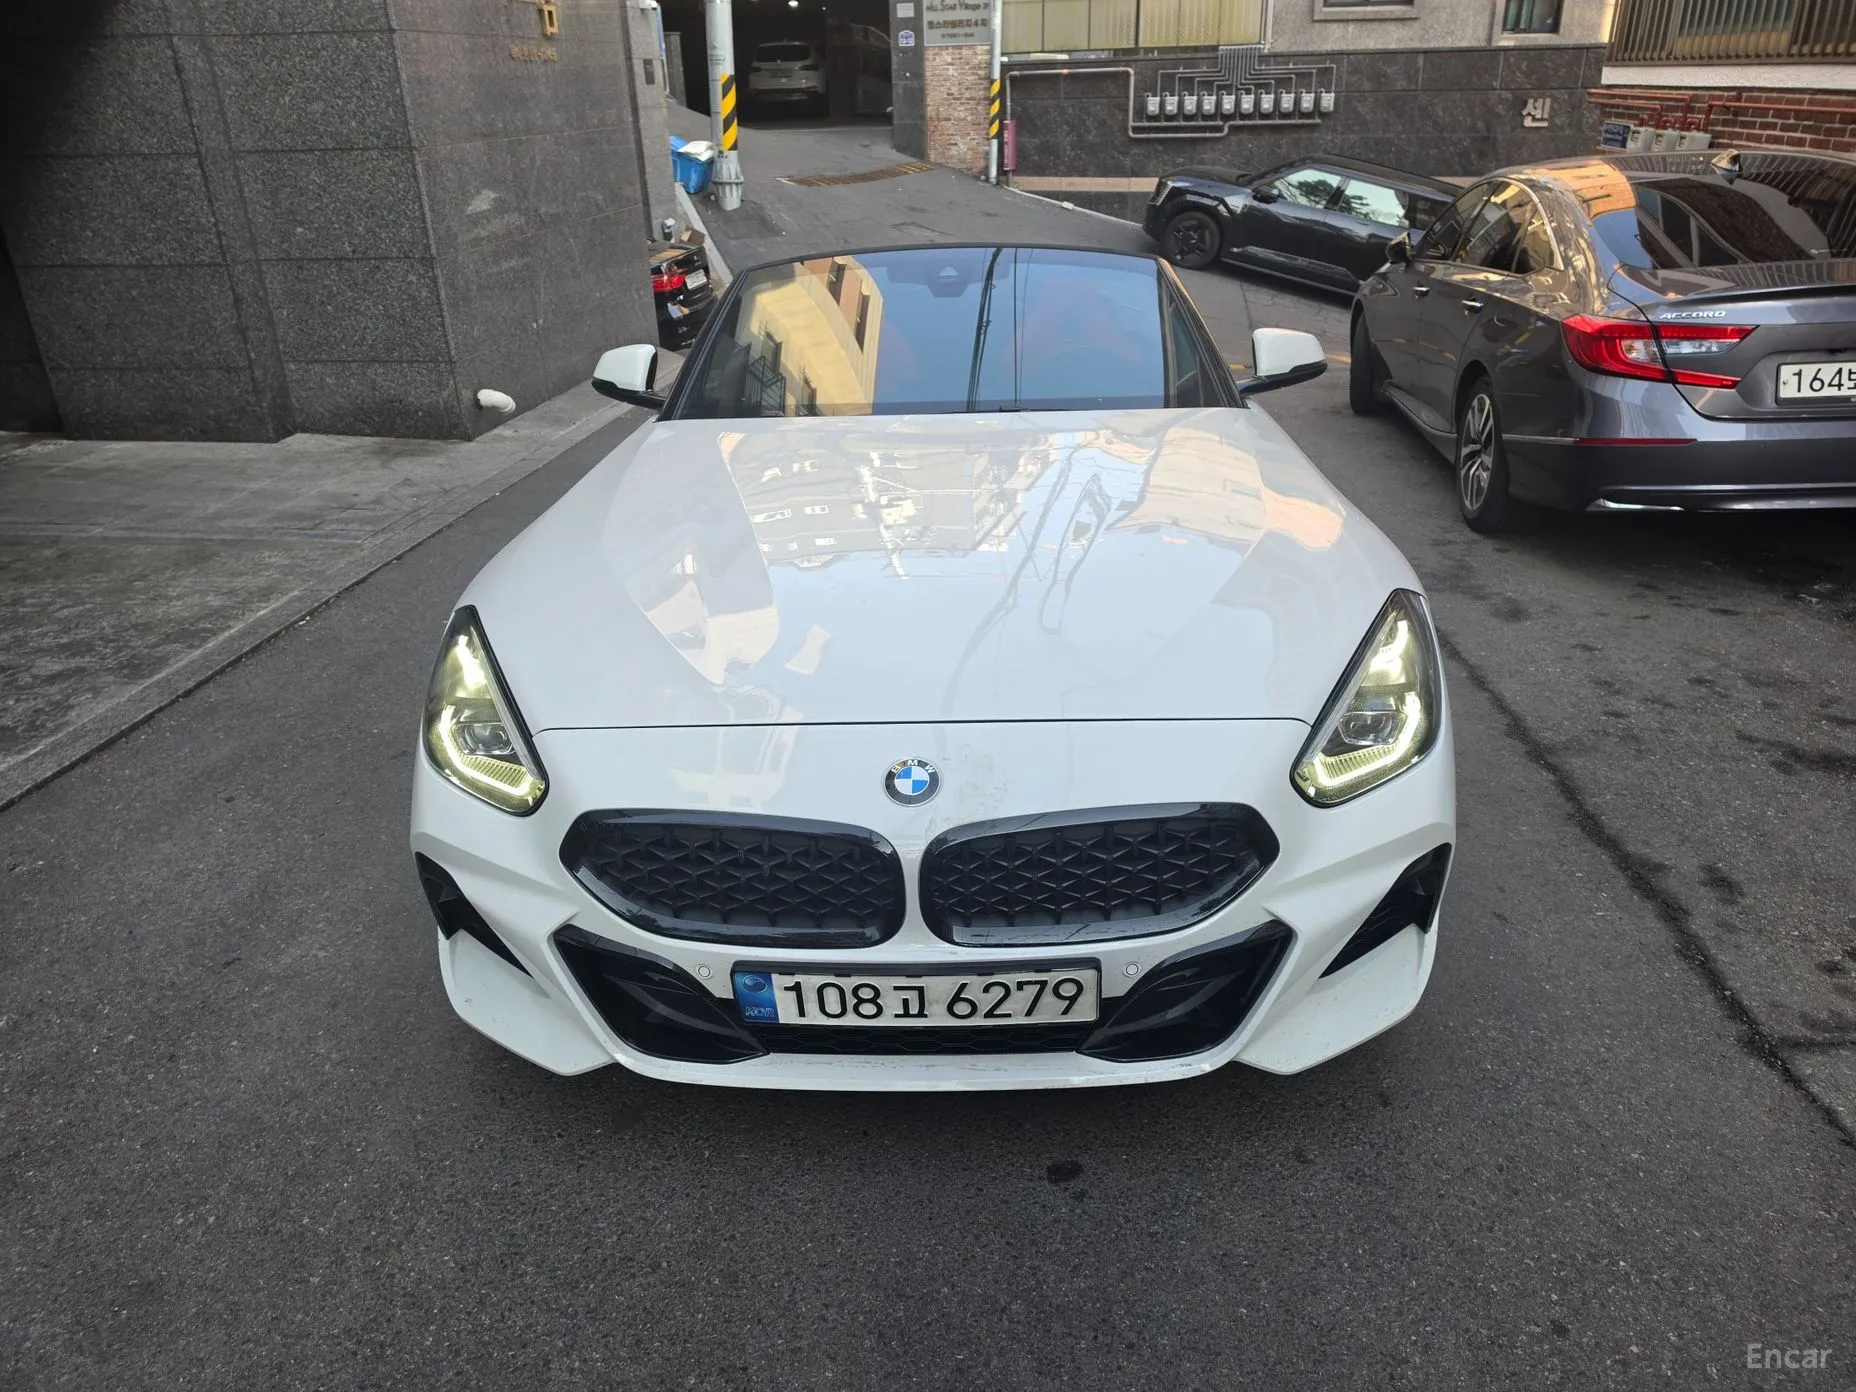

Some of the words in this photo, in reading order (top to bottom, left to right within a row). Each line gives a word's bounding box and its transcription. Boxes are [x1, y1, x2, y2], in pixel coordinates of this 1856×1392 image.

[1521, 97, 1551, 128] 센
[1659, 310, 1727, 320] ACCORD
[891, 759, 936, 774] BMW
[783, 980, 928, 1020] 108고
[946, 977, 1084, 1020] 6279
[744, 1006, 776, 1018] KOR
